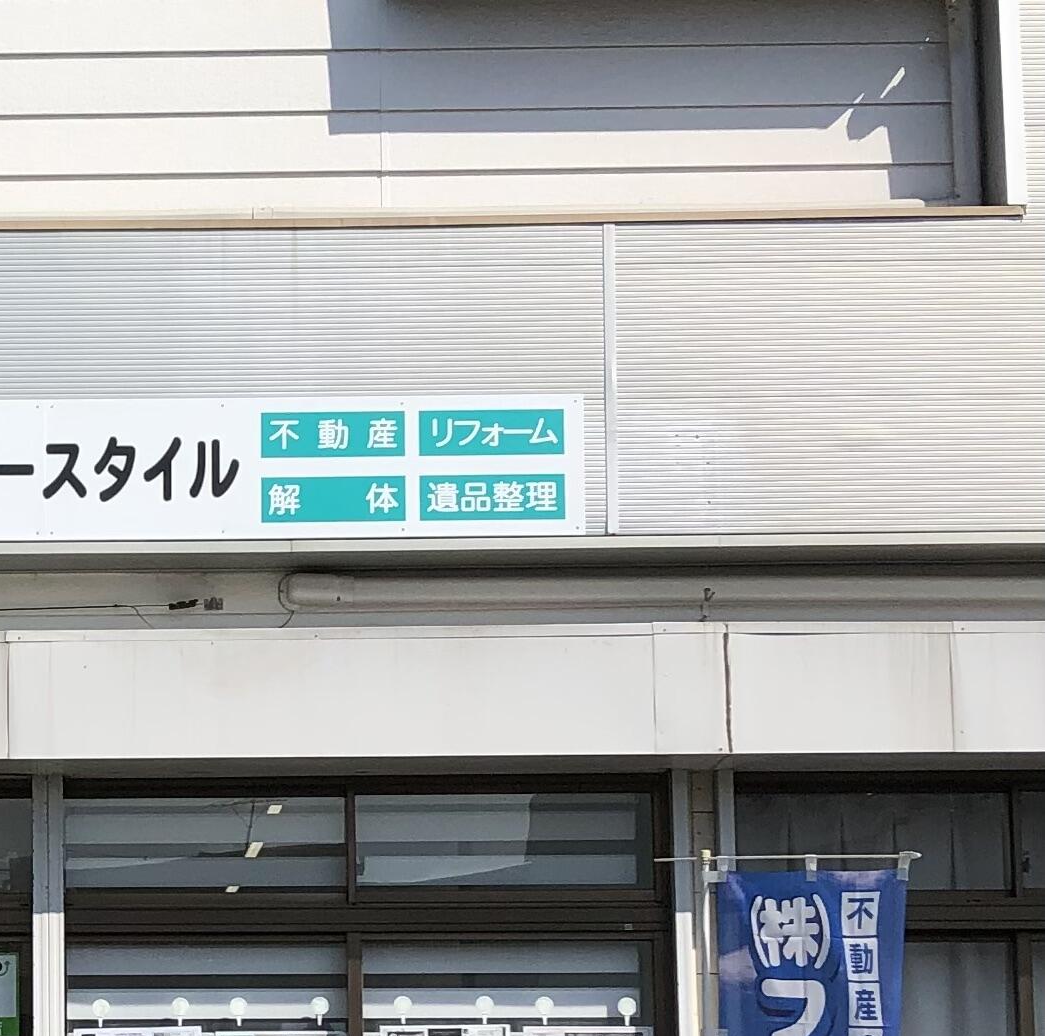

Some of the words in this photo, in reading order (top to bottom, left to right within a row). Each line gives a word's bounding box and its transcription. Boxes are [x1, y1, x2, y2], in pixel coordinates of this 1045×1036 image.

[268, 417, 399, 451] 不動産
[430, 417, 559, 449] リフォーム
[267, 482, 400, 516] 解体
[426, 480, 559, 514] 遺品整理
